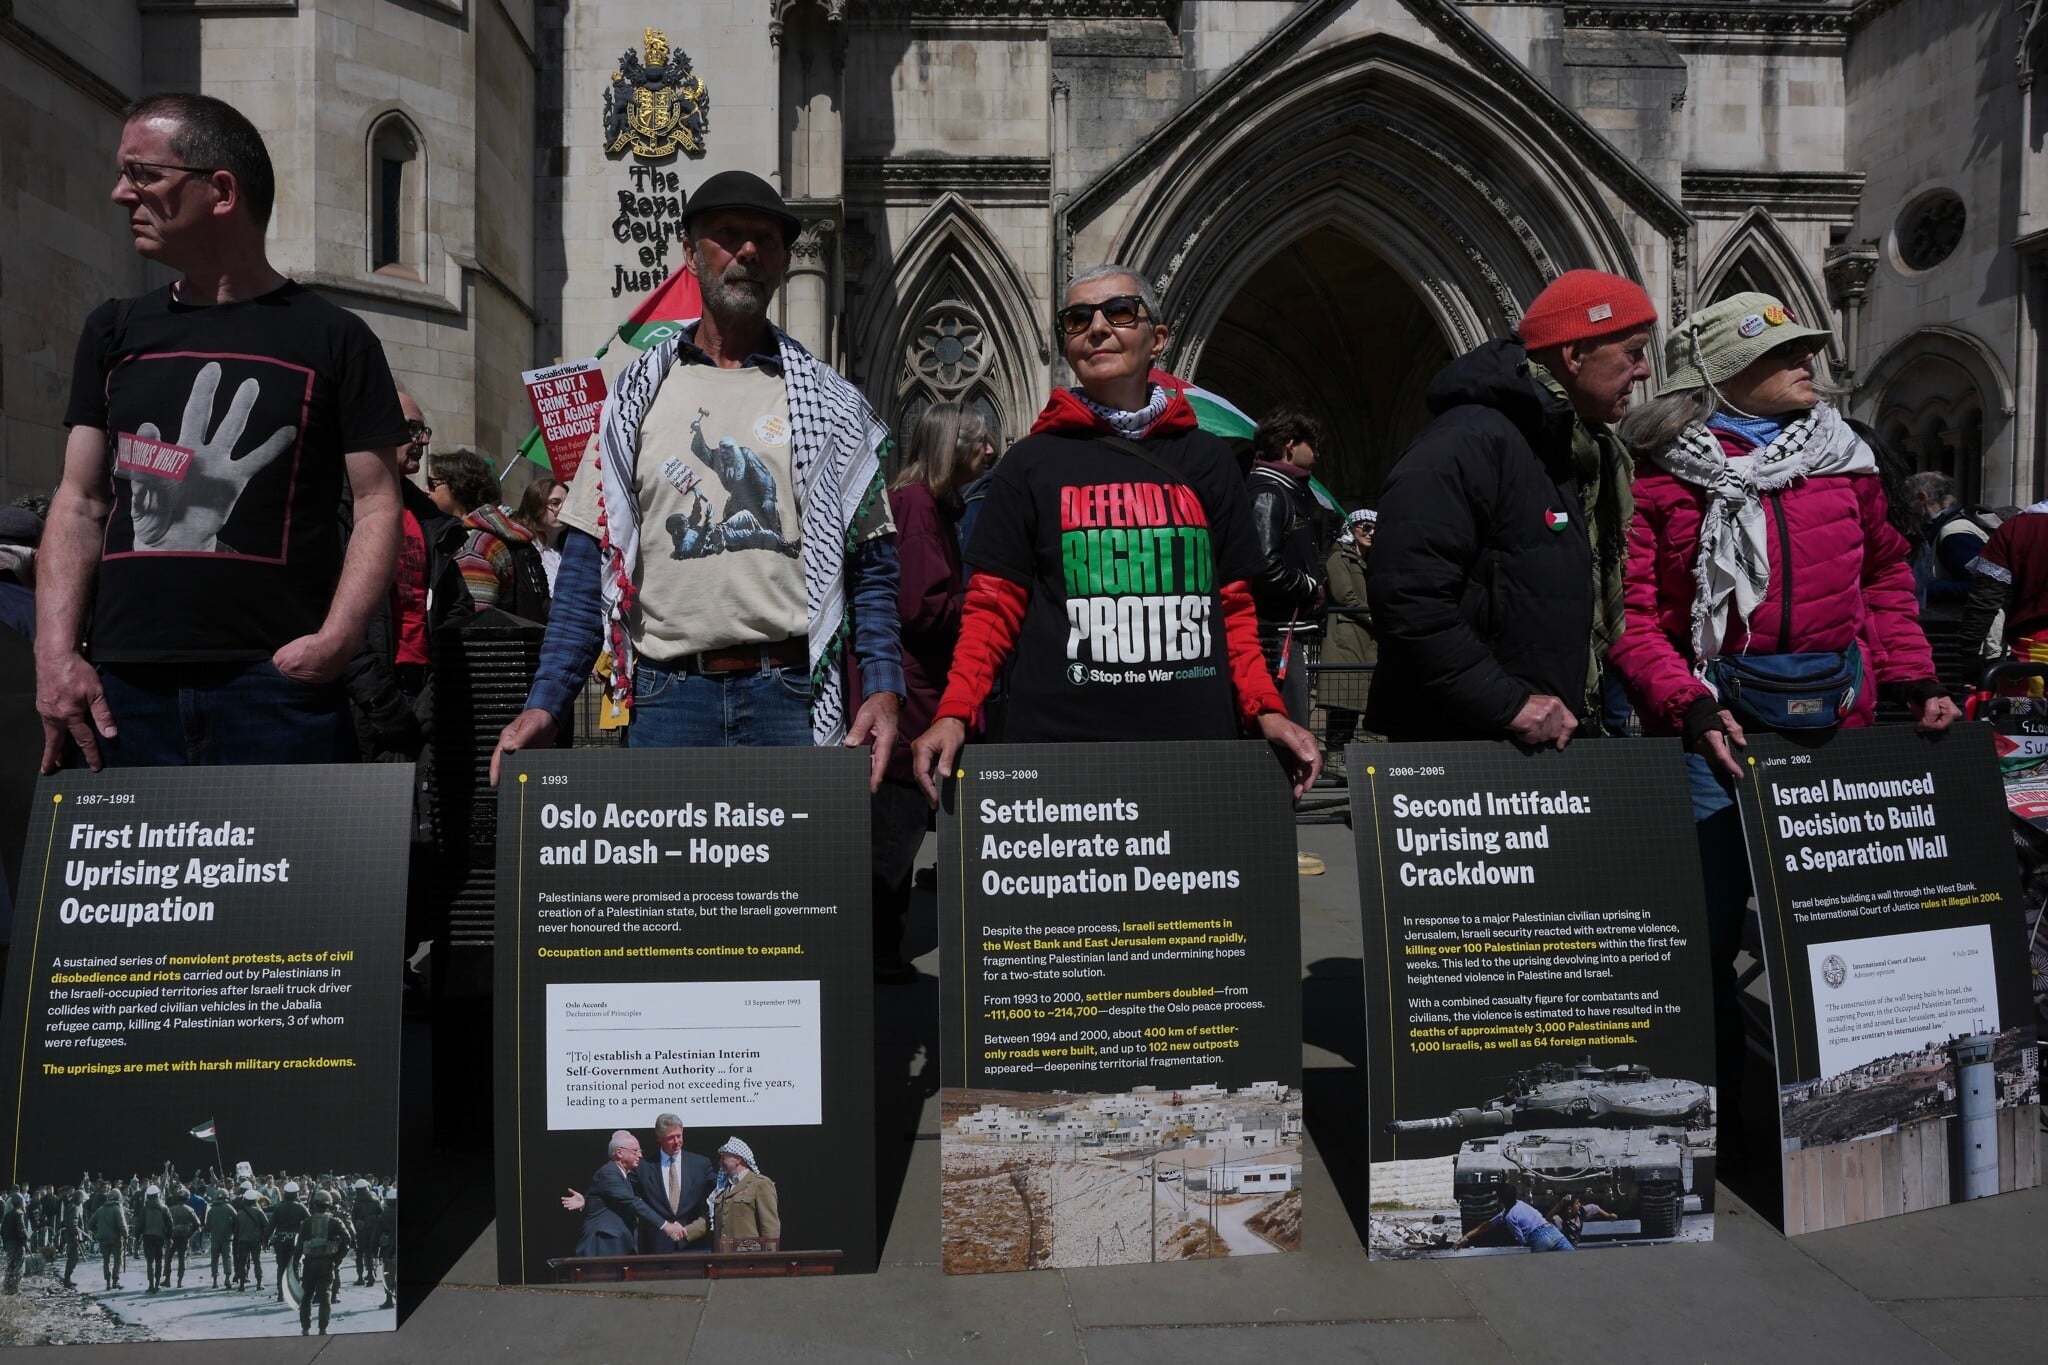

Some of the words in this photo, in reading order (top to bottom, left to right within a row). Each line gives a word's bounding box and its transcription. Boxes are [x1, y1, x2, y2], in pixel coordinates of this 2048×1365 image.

[629, 166, 679, 193] The
[617, 189, 687, 223] Royal
[638, 237, 668, 267] of
[554, 377, 576, 394] NOT
[578, 374, 588, 389] A
[537, 394, 572, 413] CRIME
[571, 390, 587, 405] TO
[542, 411, 562, 427] ACT
[132, 440, 158, 468] OWNS
[152, 447, 189, 475] WHAT?
[1060, 482, 1168, 530] DEFEND
[1061, 528, 1178, 597] RIGHT
[1177, 527, 1213, 594] TO
[1065, 596, 1212, 664] PROTEST
[1090, 668, 1123, 686] Stop
[1124, 669, 1146, 684] the
[1148, 669, 1174, 683] War
[1175, 665, 1217, 681] coalition
[1765, 757, 1786, 766] June
[1790, 754, 1811, 764] 2002
[541, 775, 567, 784] 1993
[1771, 779, 1829, 805] Israel
[1832, 772, 1934, 801] Announced
[540, 803, 596, 829] Oslo
[602, 802, 707, 828] Accords
[714, 801, 784, 827] Raise
[980, 797, 1138, 823] Settlements
[1392, 792, 1481, 818] Second
[1486, 790, 1590, 815] Intifada:
[1777, 811, 1862, 838] Decision
[1863, 810, 1885, 831] to
[1887, 803, 1935, 829] Build
[69, 823, 133, 849] First
[138, 820, 254, 847] Intifada:
[980, 833, 1119, 859] Accelerate
[1125, 830, 1170, 856] and
[1396, 826, 1501, 856] Uprising
[1504, 824, 1549, 849] and
[539, 839, 586, 865] and
[594, 838, 657, 864] Dash
[689, 838, 769, 867] Hopes
[1784, 854, 1798, 872] a
[1800, 840, 1905, 872] Separation
[1906, 834, 1948, 860] Wall
[64, 859, 179, 890] Uprising
[183, 857, 289, 888] Against
[981, 868, 1127, 898] Occupation
[1133, 866, 1239, 894] Deepens
[1399, 860, 1534, 886] Crackdown
[538, 892, 602, 902] Palestinians
[603, 894, 630, 902] were
[632, 891, 681, 903] promised
[683, 893, 690, 901] a
[692, 892, 734, 902] process
[735, 889, 779, 900] towards
[780, 889, 798, 899] the
[1791, 897, 1813, 908] Israel
[1814, 896, 1840, 907] begins
[1840, 892, 1870, 903] building
[1876, 889, 1892, 899] wall
[1892, 887, 1922, 898] through
[1922, 886, 1935, 895] the
[1935, 884, 1955, 893] West
[1956, 881, 1977, 891] Bank.
[59, 895, 214, 927] Occupation
[982, 925, 1022, 936] Despite
[1024, 924, 1042, 934] the
[1044, 925, 1075, 935] peace
[1077, 924, 1120, 934] process,
[1122, 920, 1155, 931] Israeli
[1157, 919, 1221, 930] settlements
[1222, 918, 1232, 927] in
[537, 946, 601, 958] Occupation
[603, 946, 624, 956] and
[626, 946, 694, 956] settlements
[695, 945, 744, 955] continue
[746, 945, 759, 954] to
[760, 944, 804, 956] expand.
[1405, 944, 1437, 955] killing
[1438, 945, 1461, 953] over
[1462, 942, 1482, 952] 100
[1484, 941, 1540, 952] Palestinian
[1542, 940, 1597, 952] protesters
[1598, 938, 1627, 948] within
[1628, 938, 1645, 947] the
[1647, 937, 1668, 947] first
[1669, 936, 1686, 946] few
[50, 972, 127, 983] disobedience
[129, 970, 151, 981] and
[153, 970, 181, 981] riots
[182, 969, 223, 980] carried
[224, 969, 243, 979] out
[246, 968, 259, 980] by
[261, 967, 328, 978] Palestinians
[330, 966, 340, 977] in
[593, 1050, 642, 1060] establish
[654, 1049, 715, 1059] Palestinian
[719, 1048, 760, 1058] Interim
[1410, 1041, 1440, 1053] 1,000
[1441, 1040, 1482, 1050] Israelis,
[1484, 1041, 1496, 1049] as
[1497, 1038, 1518, 1048] well
[1533, 1037, 1548, 1046] 64
[1549, 1036, 1586, 1046] foreign
[1588, 1034, 1637, 1044] nationals.
[42, 1063, 64, 1074] The
[67, 1062, 121, 1075] uprisings
[123, 1064, 143, 1072] are
[145, 1061, 169, 1071] met
[171, 1060, 197, 1071] with
[199, 1059, 232, 1070] harsh
[235, 1058, 280, 1070] military
[282, 1056, 356, 1068] crackdowns.
